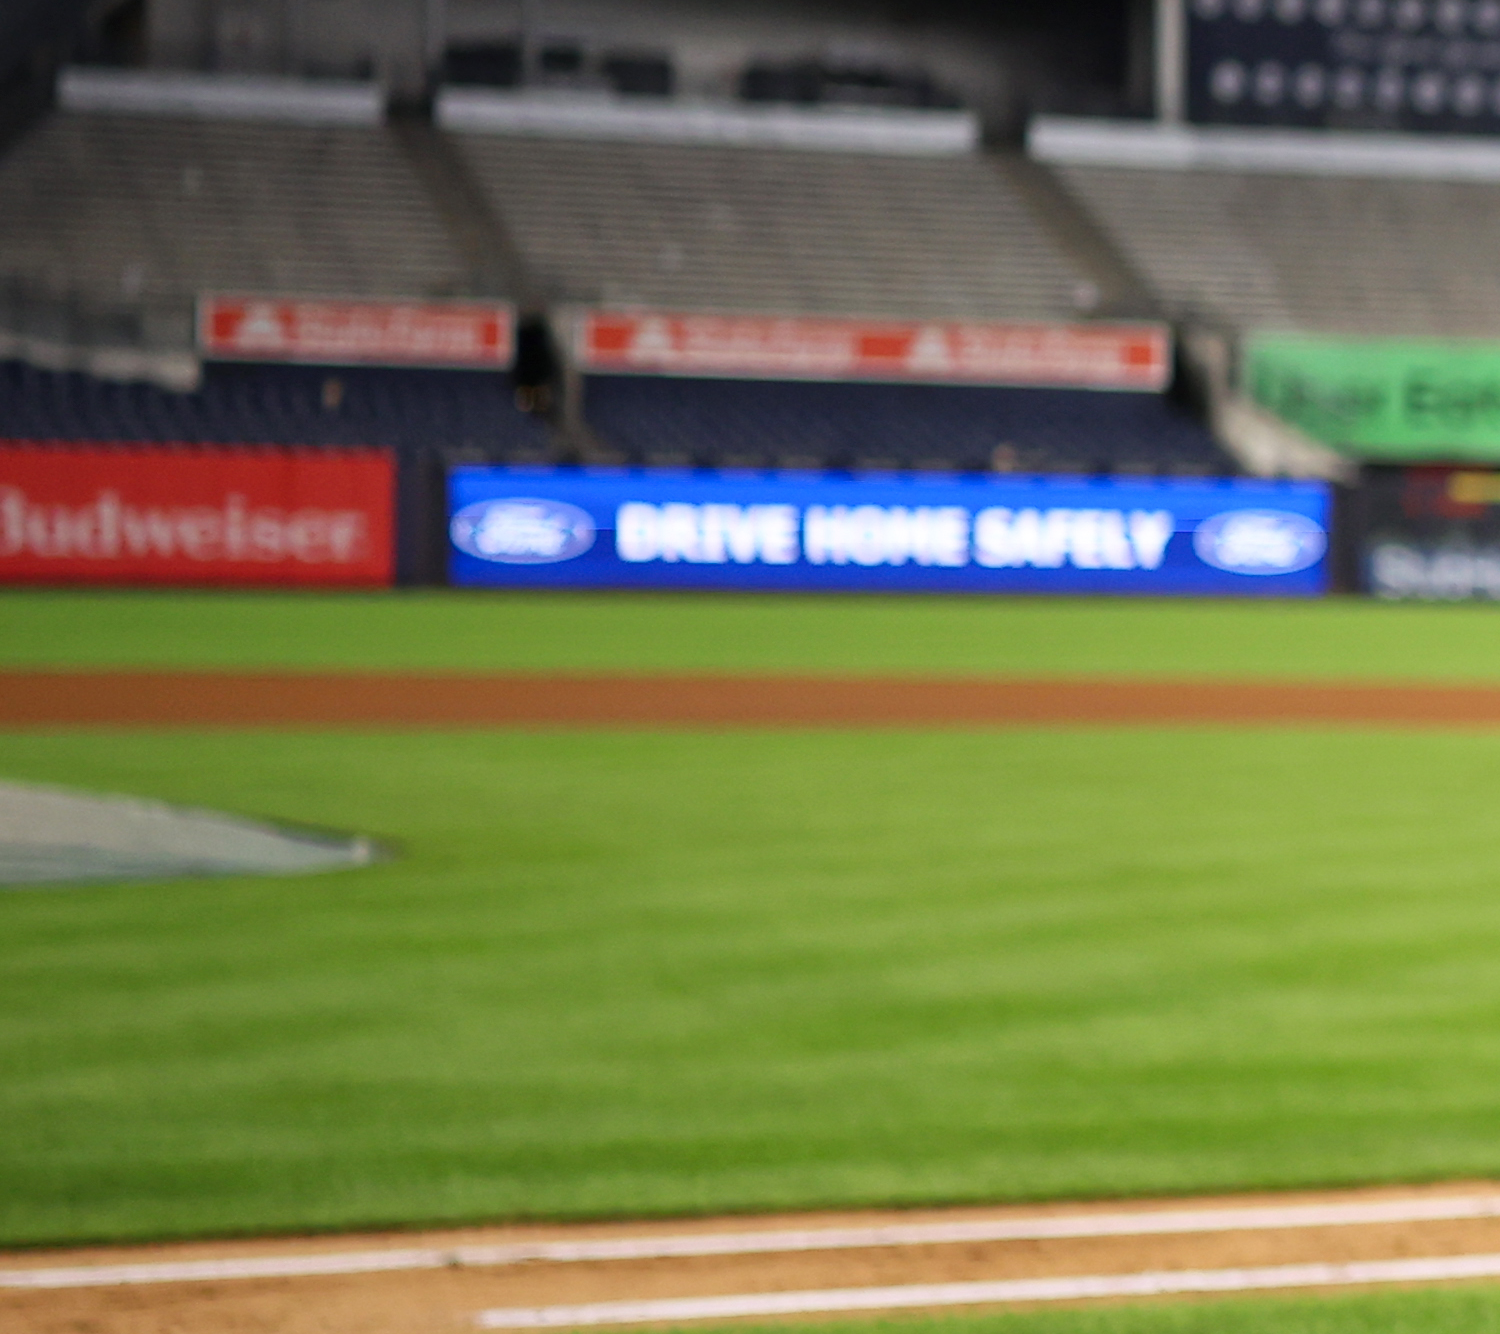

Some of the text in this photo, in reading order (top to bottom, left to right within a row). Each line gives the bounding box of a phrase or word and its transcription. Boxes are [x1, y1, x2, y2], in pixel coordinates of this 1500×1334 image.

[616, 501, 799, 566] DRIVE
[803, 504, 969, 567] HOME
[973, 507, 1174, 570] SAFELY
